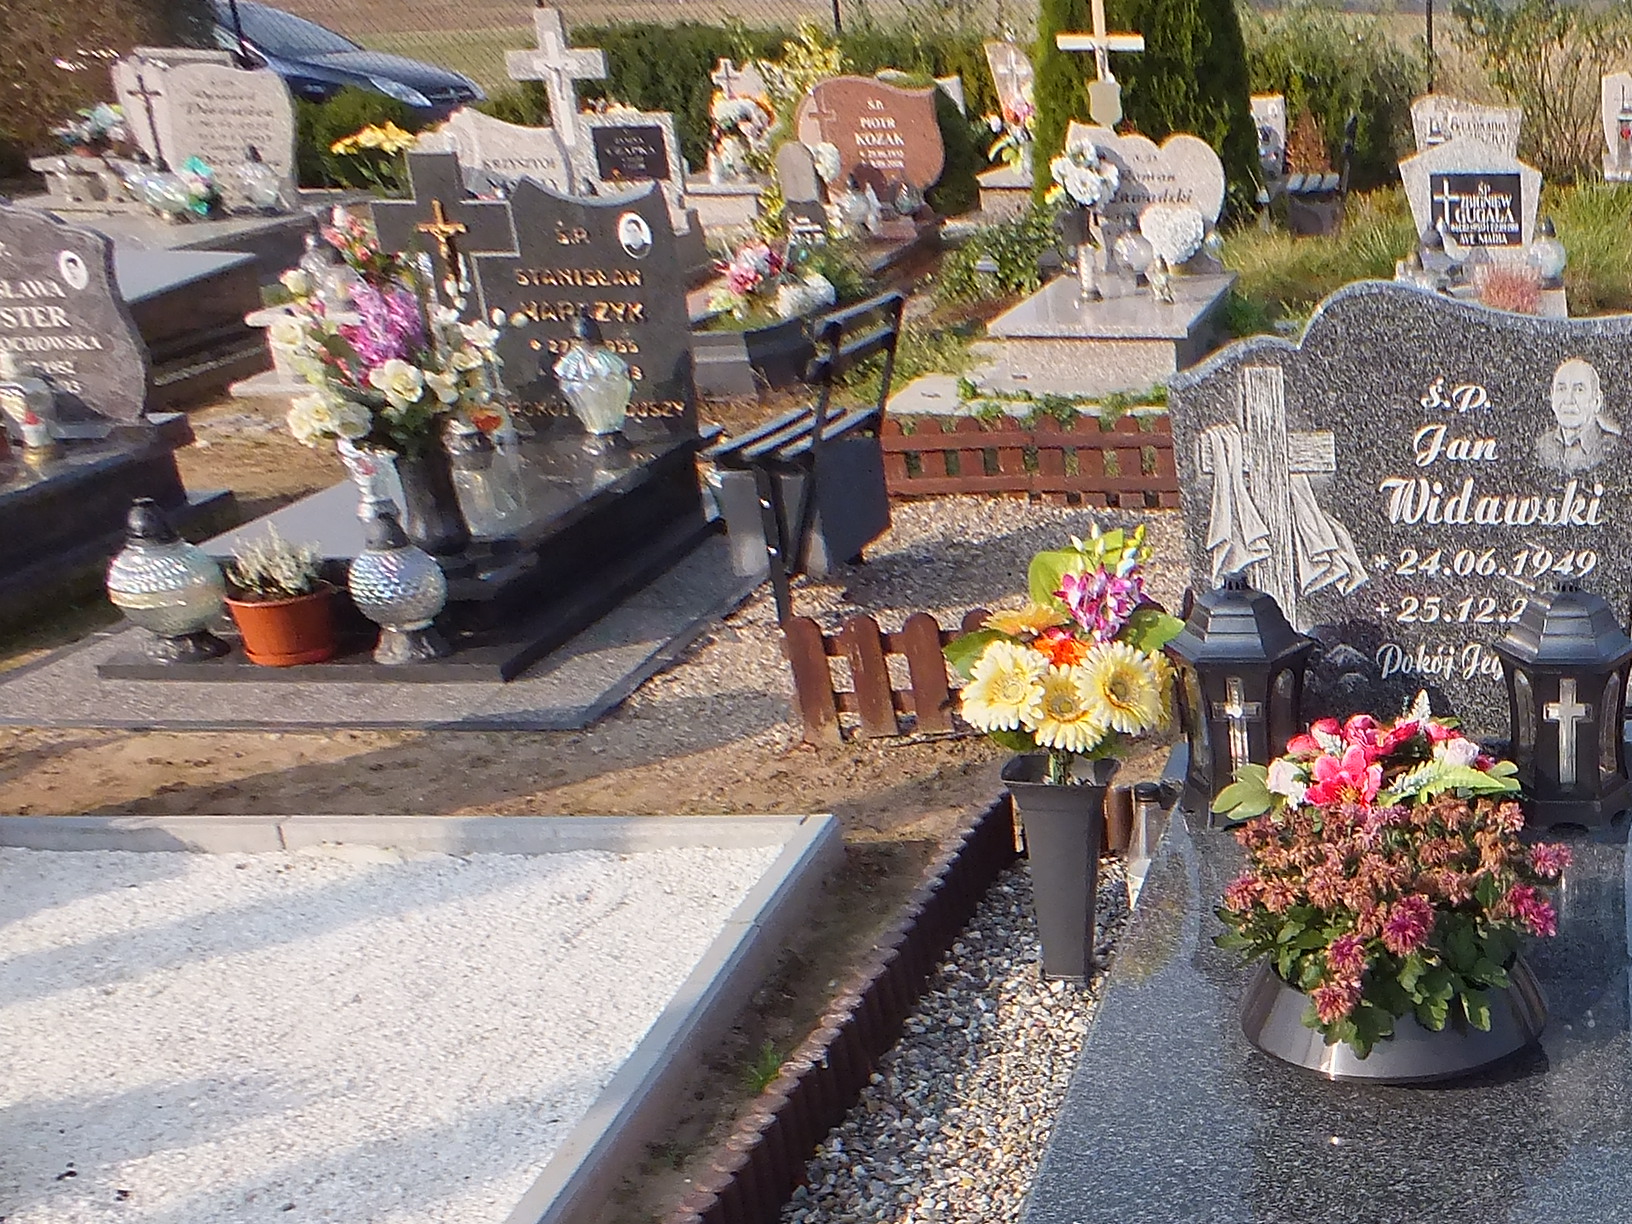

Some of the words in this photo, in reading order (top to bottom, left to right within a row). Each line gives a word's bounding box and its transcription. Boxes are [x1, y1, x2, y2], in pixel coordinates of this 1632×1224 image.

[1413, 423, 1500, 468] Jan
[1378, 476, 1604, 527] Widawski
[1396, 548, 1598, 578] 24.06.1949
[1375, 641, 1455, 680] Pokój
